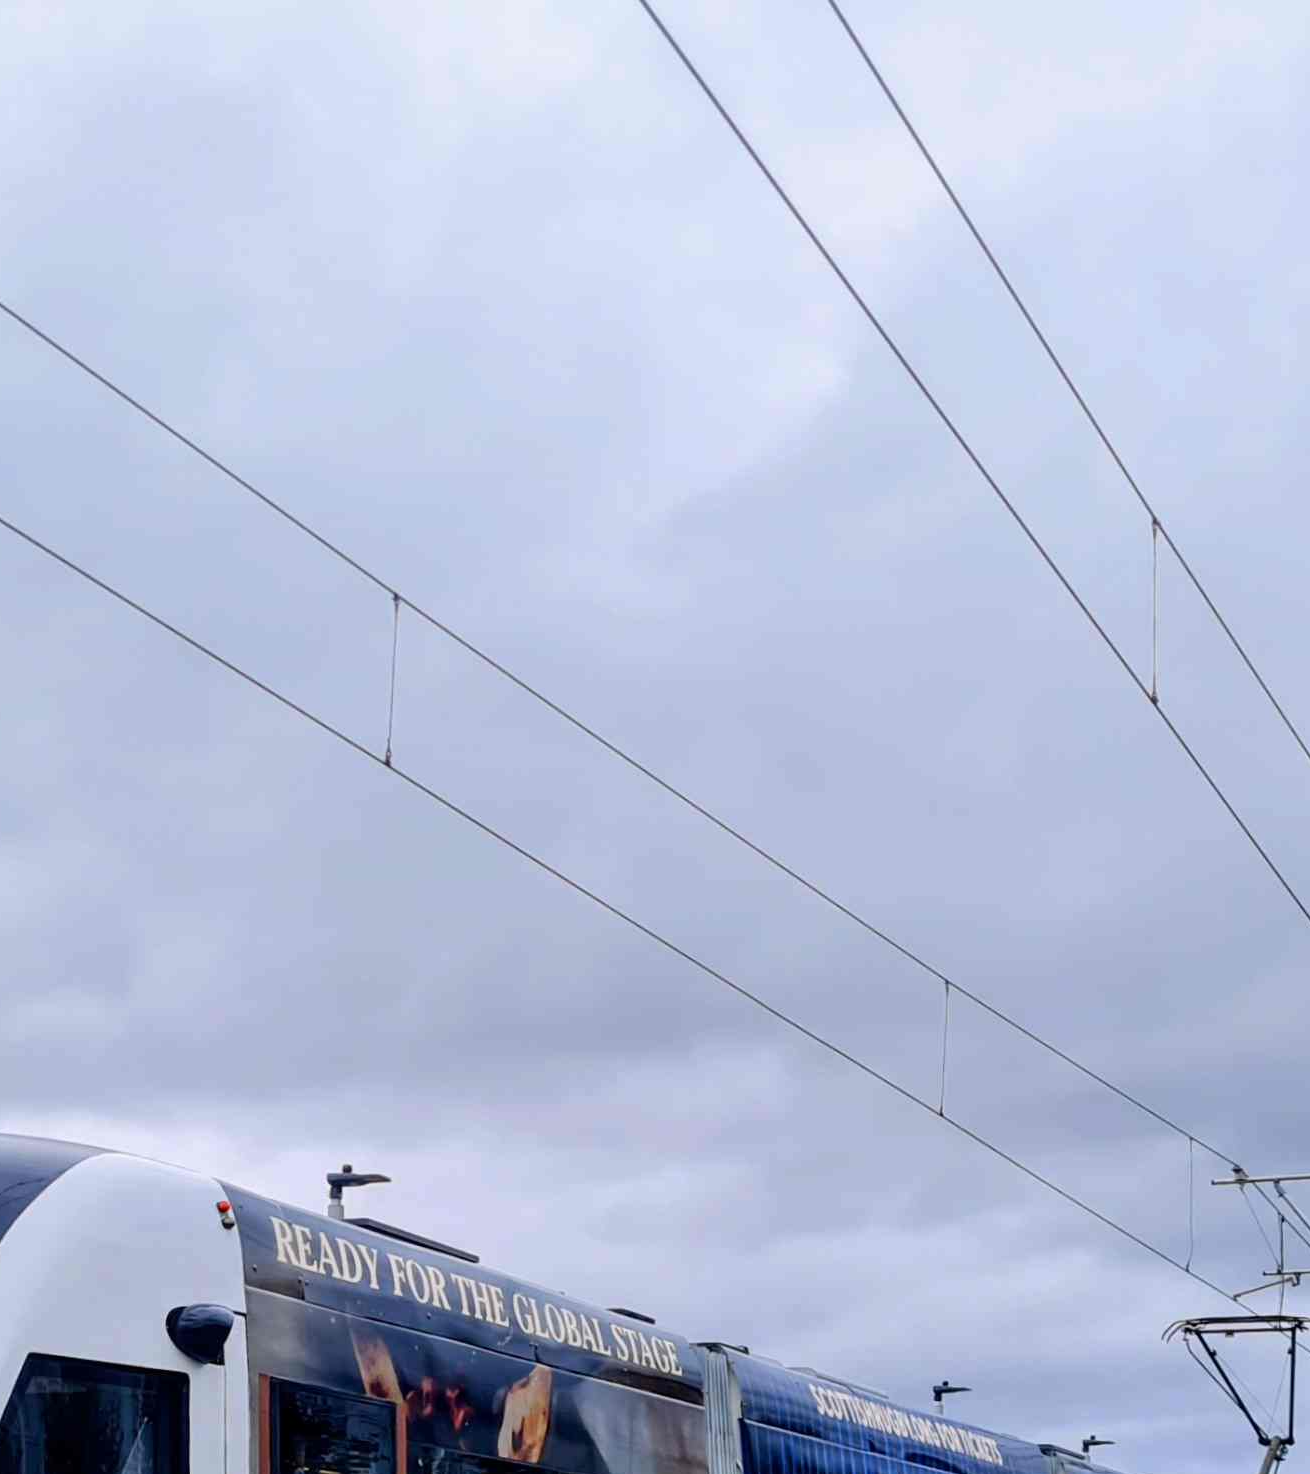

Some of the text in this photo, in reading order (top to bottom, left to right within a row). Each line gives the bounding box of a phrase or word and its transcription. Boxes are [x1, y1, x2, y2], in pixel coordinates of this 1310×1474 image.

[270, 1216, 682, 1376] READY FOR THE GLOBAL STAGE
